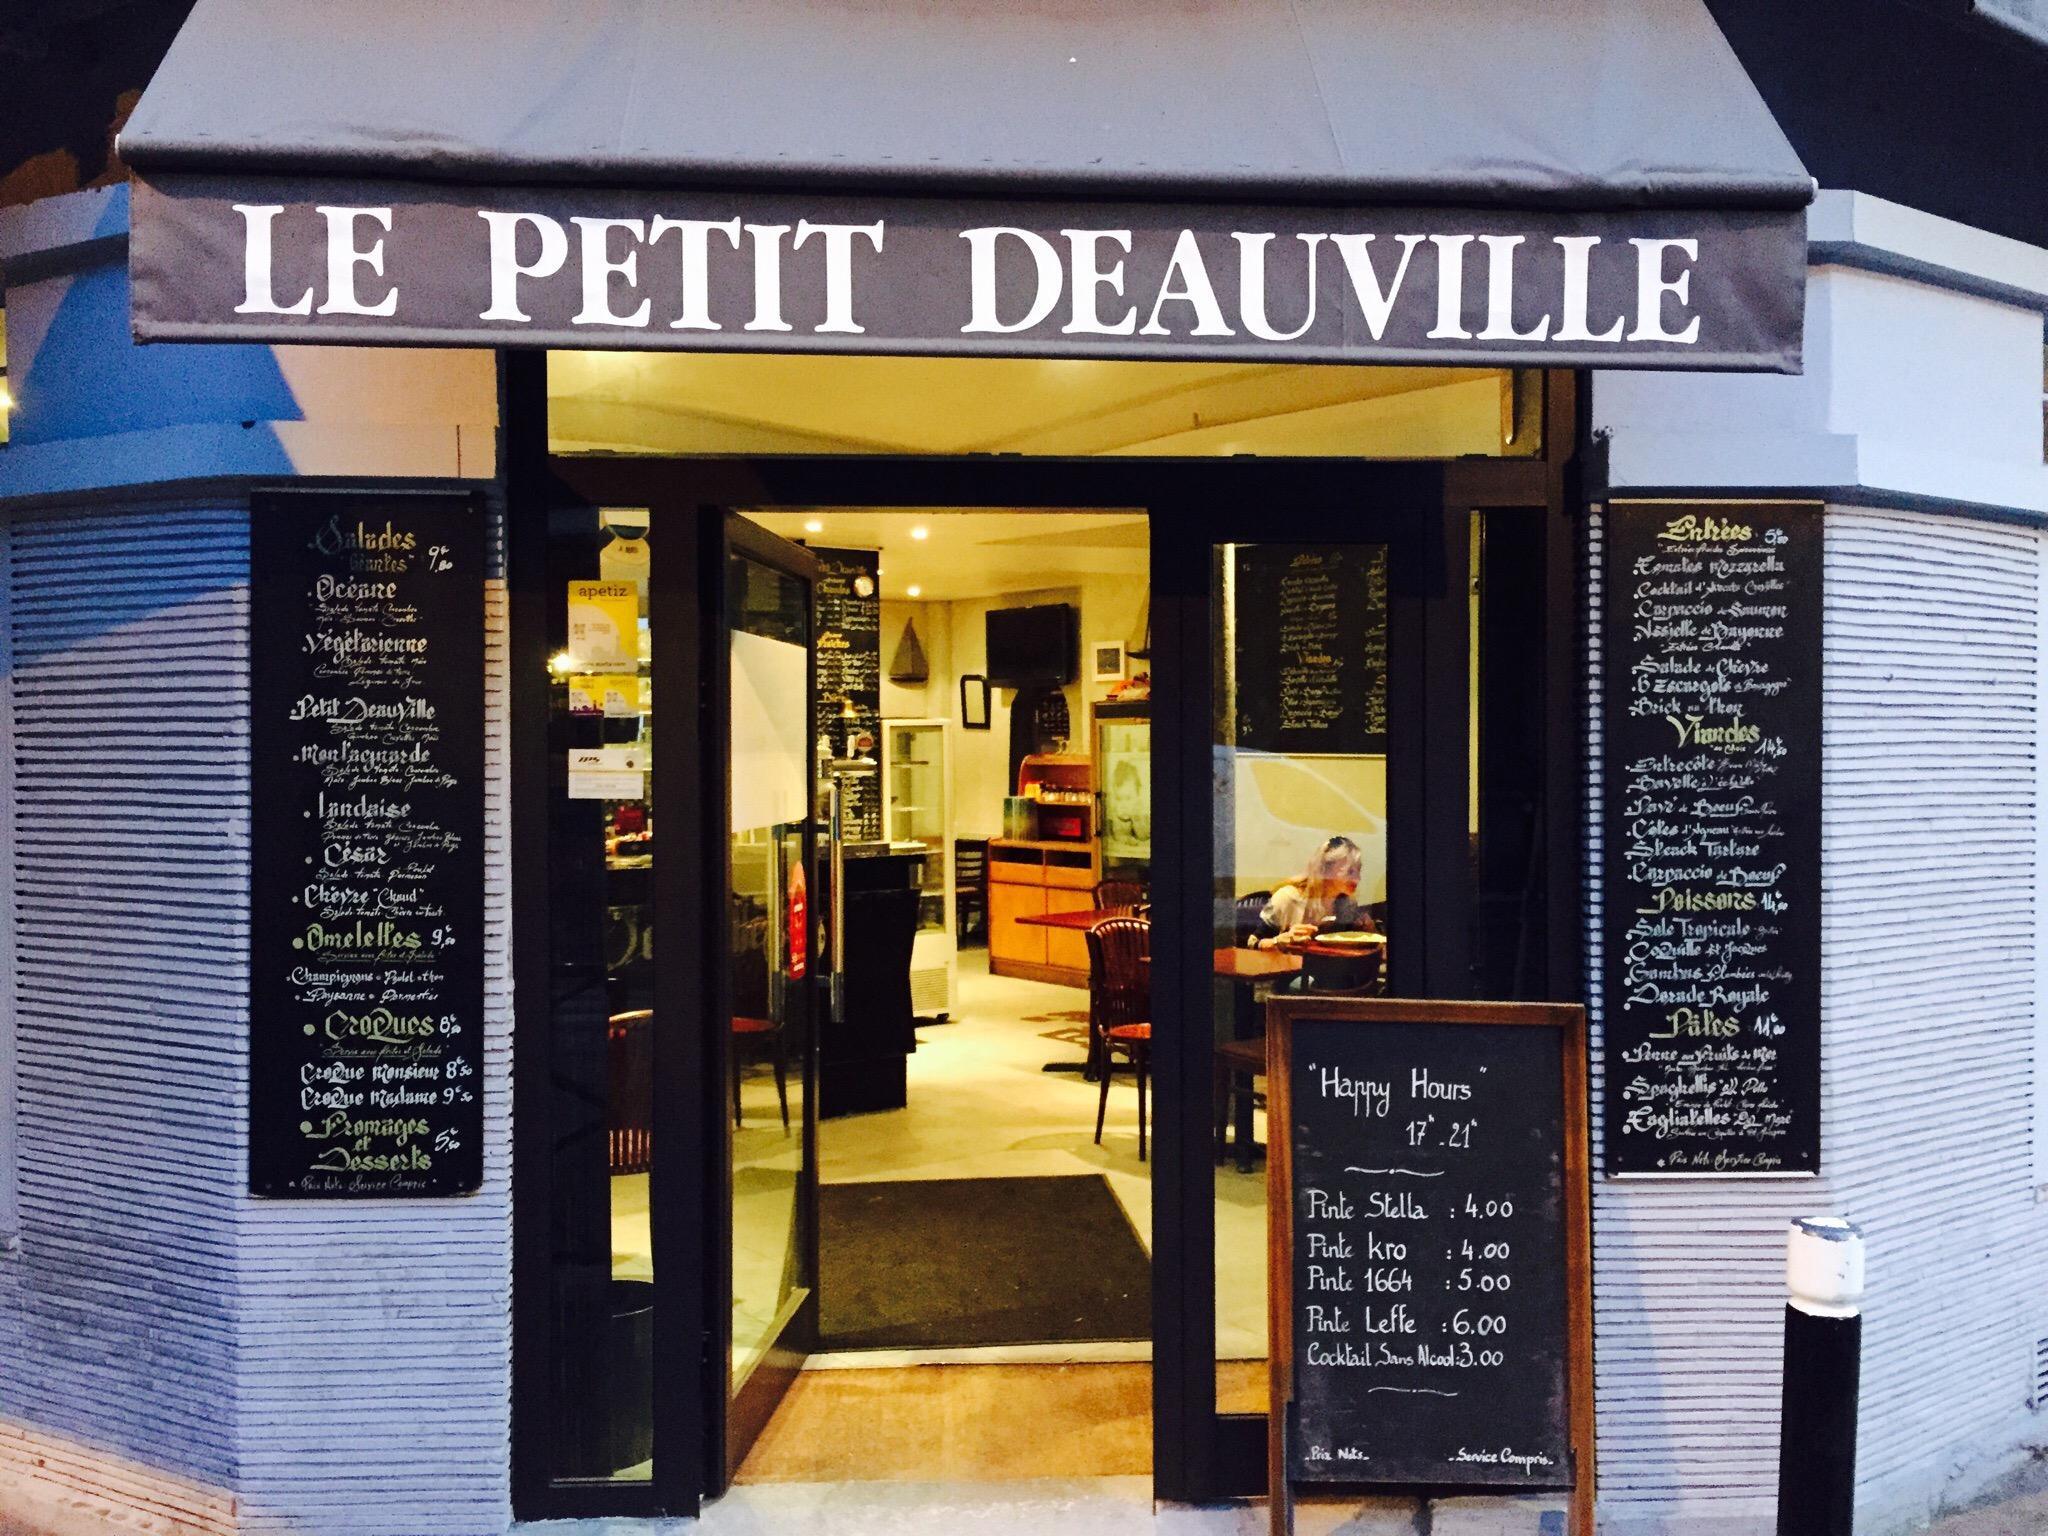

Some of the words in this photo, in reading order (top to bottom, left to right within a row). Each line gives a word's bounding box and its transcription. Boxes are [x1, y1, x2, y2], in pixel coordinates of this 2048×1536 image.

[233, 204, 398, 316] LE
[478, 210, 885, 334] PETIT
[959, 227, 1700, 344] DEAUVILLE
[1657, 515, 1752, 541] Entrées
[316, 574, 397, 601] Océane
[578, 584, 628, 600] apetiz
[304, 628, 428, 664] Végétarienne
[289, 694, 340, 720] Petit
[326, 696, 436, 723] Deauville
[1666, 714, 1761, 749] Viandes
[301, 740, 430, 769] Montagnarde
[319, 791, 411, 819] Landaise
[324, 841, 392, 867] César
[304, 884, 370, 909] Chèvre
[1636, 887, 1757, 914] Poissons
[306, 920, 422, 952] Omelettes
[1649, 1007, 1740, 1039] Pâtes
[305, 1110, 430, 1147] Fromages
[310, 1145, 432, 1171] Desserts
[1307, 1189, 1354, 1219] Pinte
[1364, 1191, 1429, 1219] Stella
[1465, 1193, 1513, 1219] 4.00
[1307, 1233, 1352, 1259] Pinte
[1461, 1239, 1510, 1260] 4.00
[1307, 1265, 1353, 1291] Pinte
[1364, 1267, 1412, 1292] 1664
[1457, 1268, 1511, 1292] 5.00
[1306, 1305, 1350, 1333] Pinte
[1366, 1304, 1416, 1333] Leffe
[1307, 1341, 1372, 1367] Cocktail
[1375, 1342, 1414, 1366] Sans
